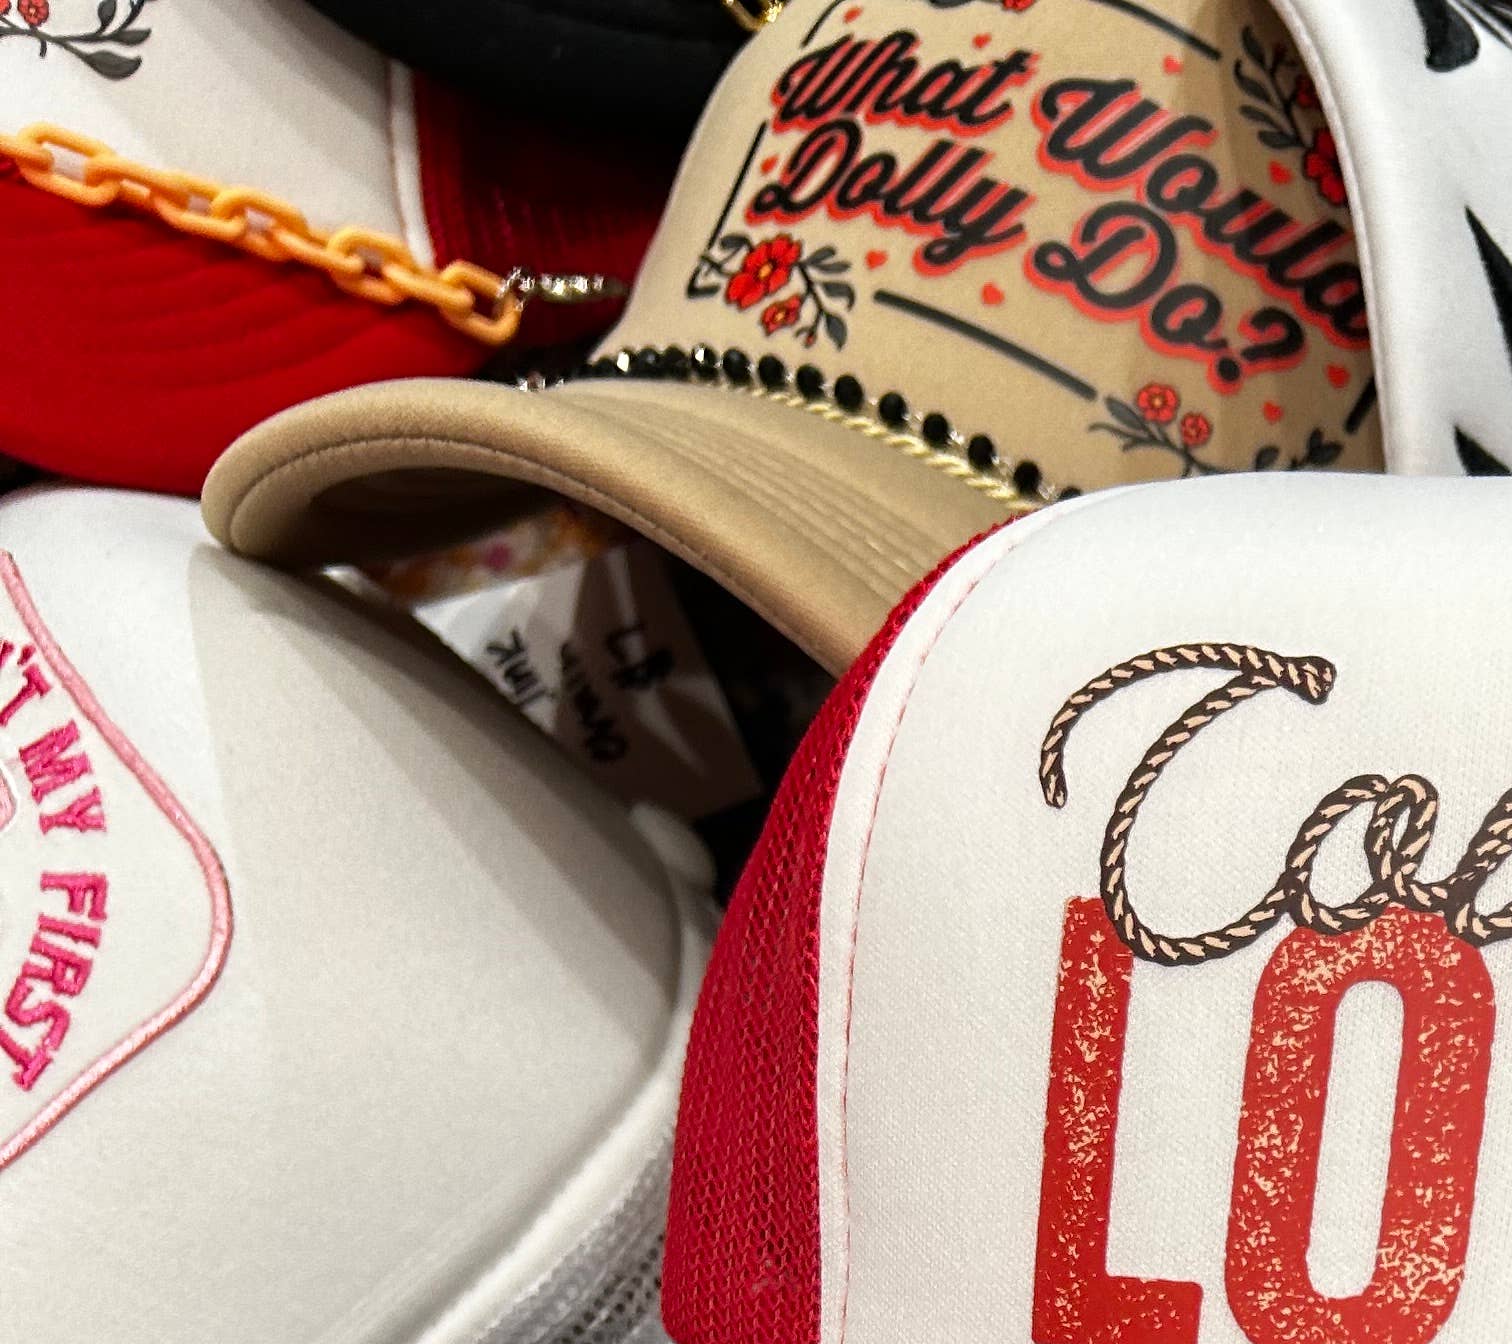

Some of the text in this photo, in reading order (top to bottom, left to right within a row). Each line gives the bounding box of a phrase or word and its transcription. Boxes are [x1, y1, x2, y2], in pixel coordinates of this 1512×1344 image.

[771, 28, 1042, 137] What
[745, 118, 1308, 394] Dolly Do?
[18, 718, 108, 836] MY
[0, 871, 109, 1092] FIRST
